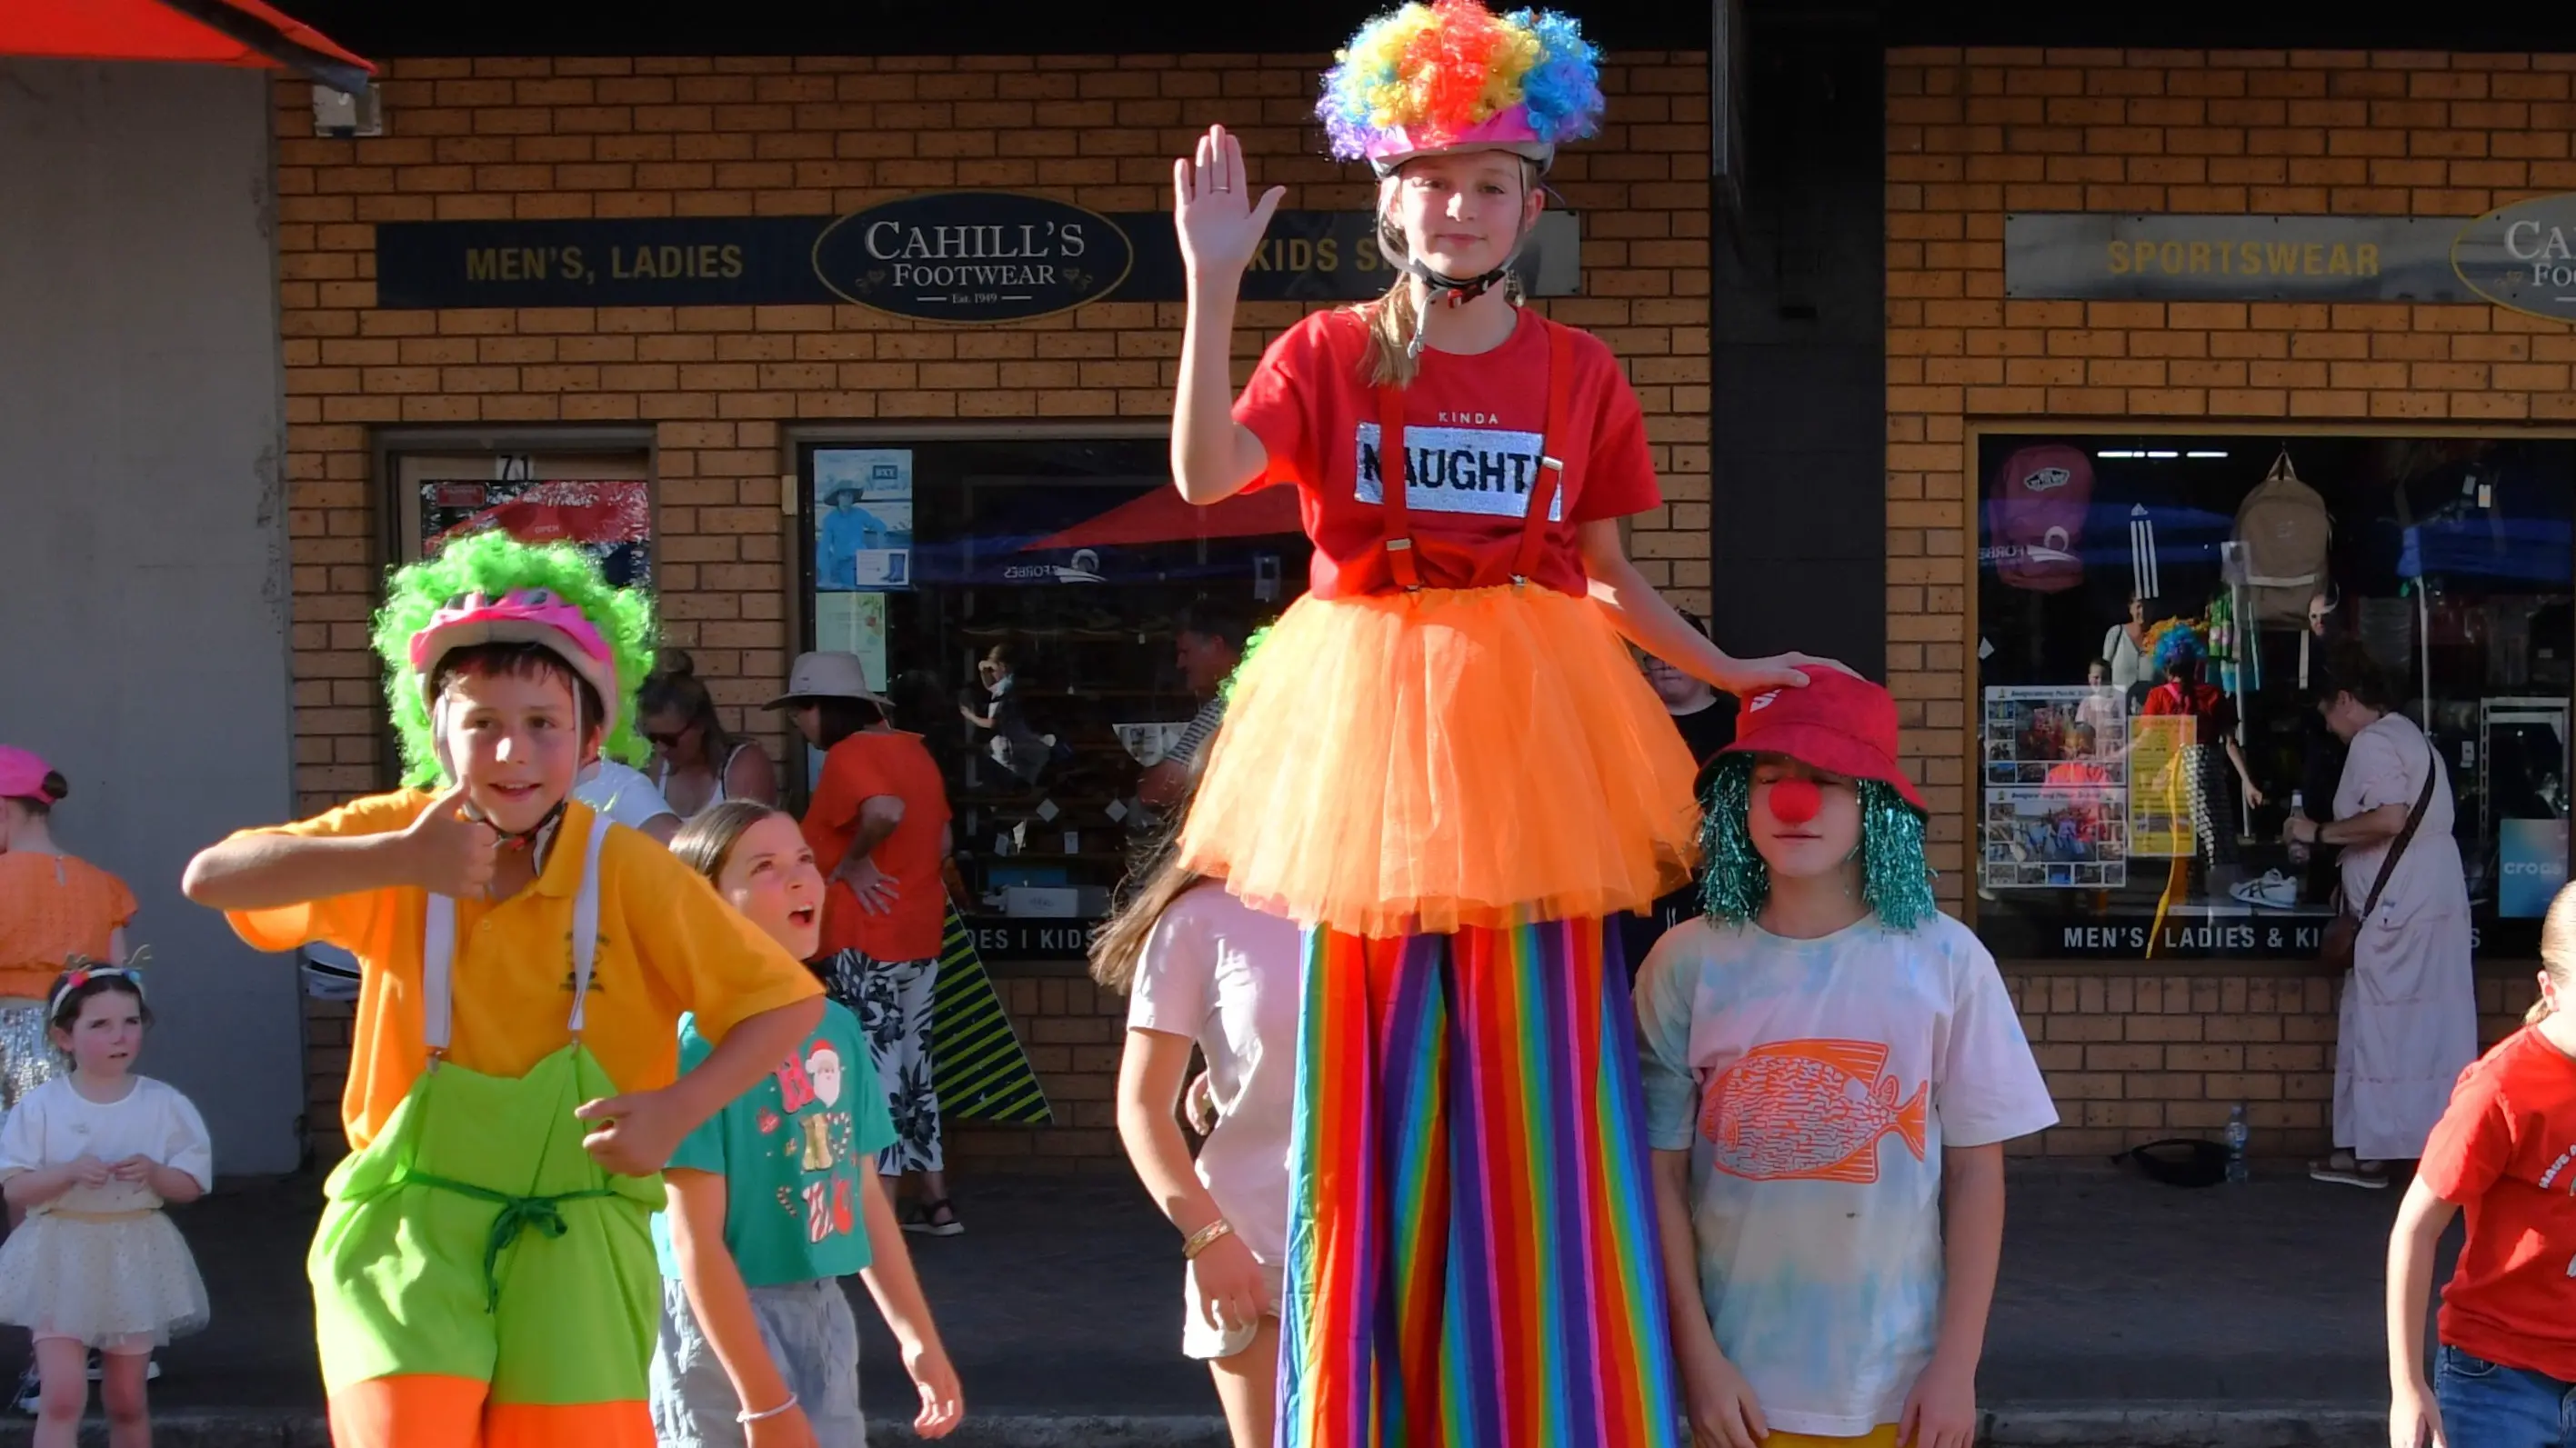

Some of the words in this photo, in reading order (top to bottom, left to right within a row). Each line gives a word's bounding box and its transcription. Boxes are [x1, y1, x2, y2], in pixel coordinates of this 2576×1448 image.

[865, 221, 1085, 260] CAHILL'S
[2504, 220, 2576, 259] CA
[466, 246, 595, 285] MEN'S,
[611, 245, 743, 278] LADIES
[1248, 238, 1338, 272] KIDS
[2107, 240, 2379, 275] SPORTSWEAR
[892, 264, 1057, 286] FOOTWEAR
[2531, 263, 2576, 287] FO
[952, 294, 971, 305] Est.
[975, 293, 997, 304] 1949
[1438, 412, 1498, 424] KINDA
[501, 454, 530, 481] 71
[2164, 927, 2255, 948] LADIES
[2266, 927, 2283, 948] &
[2539, 1153, 2571, 1189] HAVE
